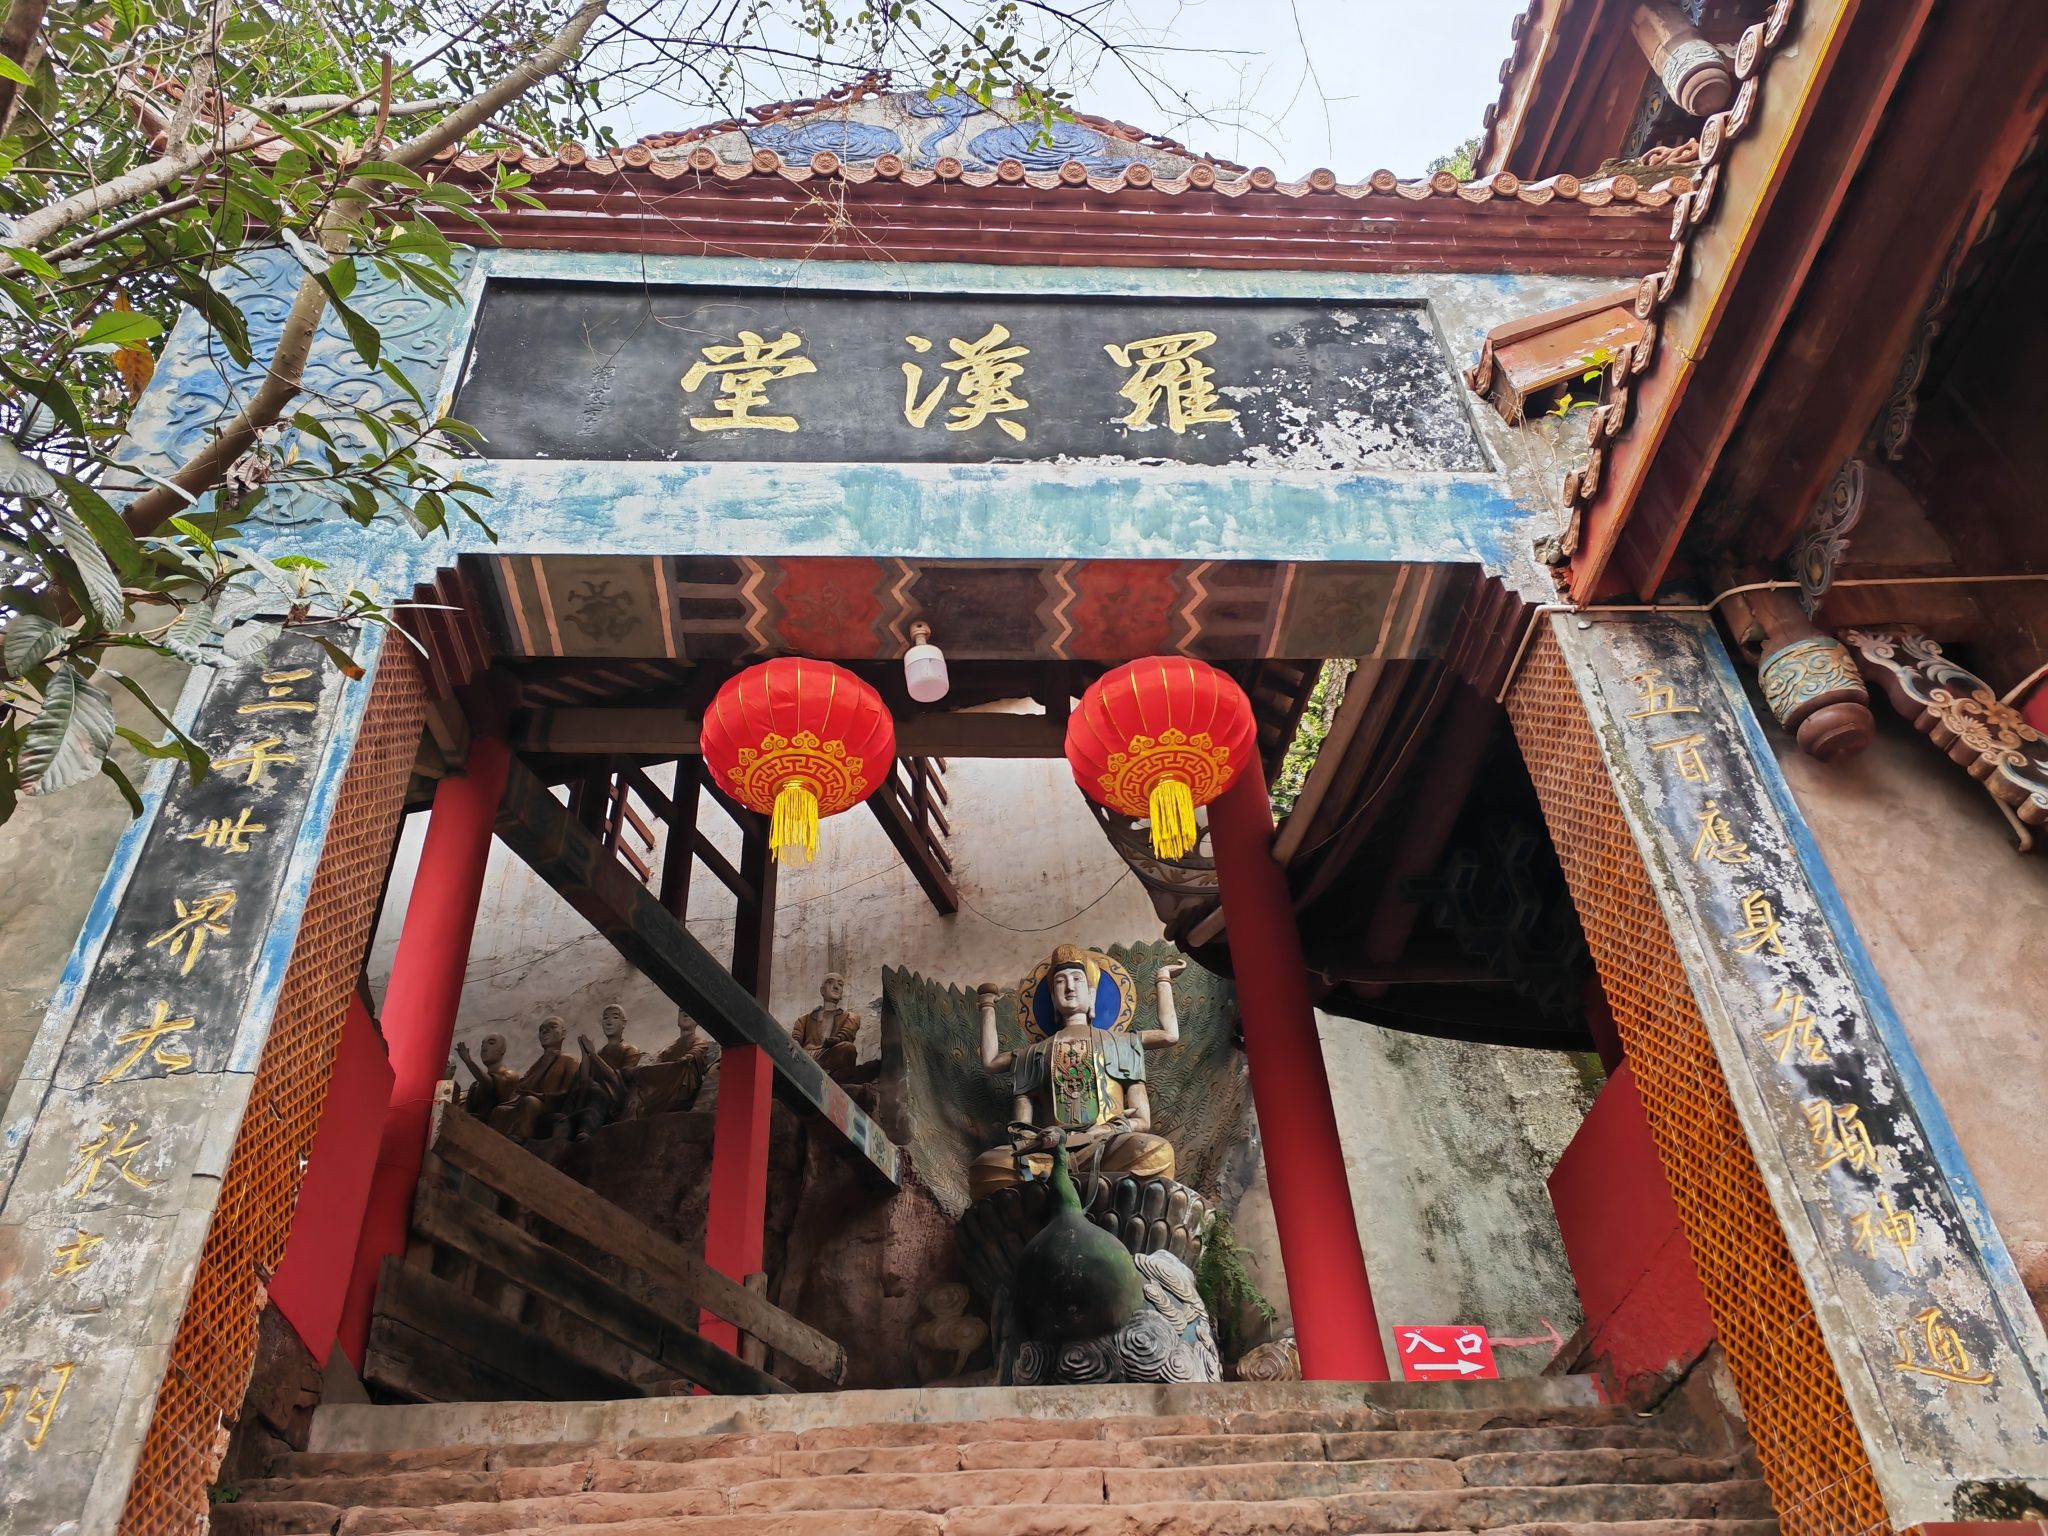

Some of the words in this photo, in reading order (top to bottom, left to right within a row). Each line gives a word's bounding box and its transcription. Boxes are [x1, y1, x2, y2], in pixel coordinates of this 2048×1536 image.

[680, 323, 1240, 441] 羅漢堂
[1403, 1332, 1483, 1355] 入口
